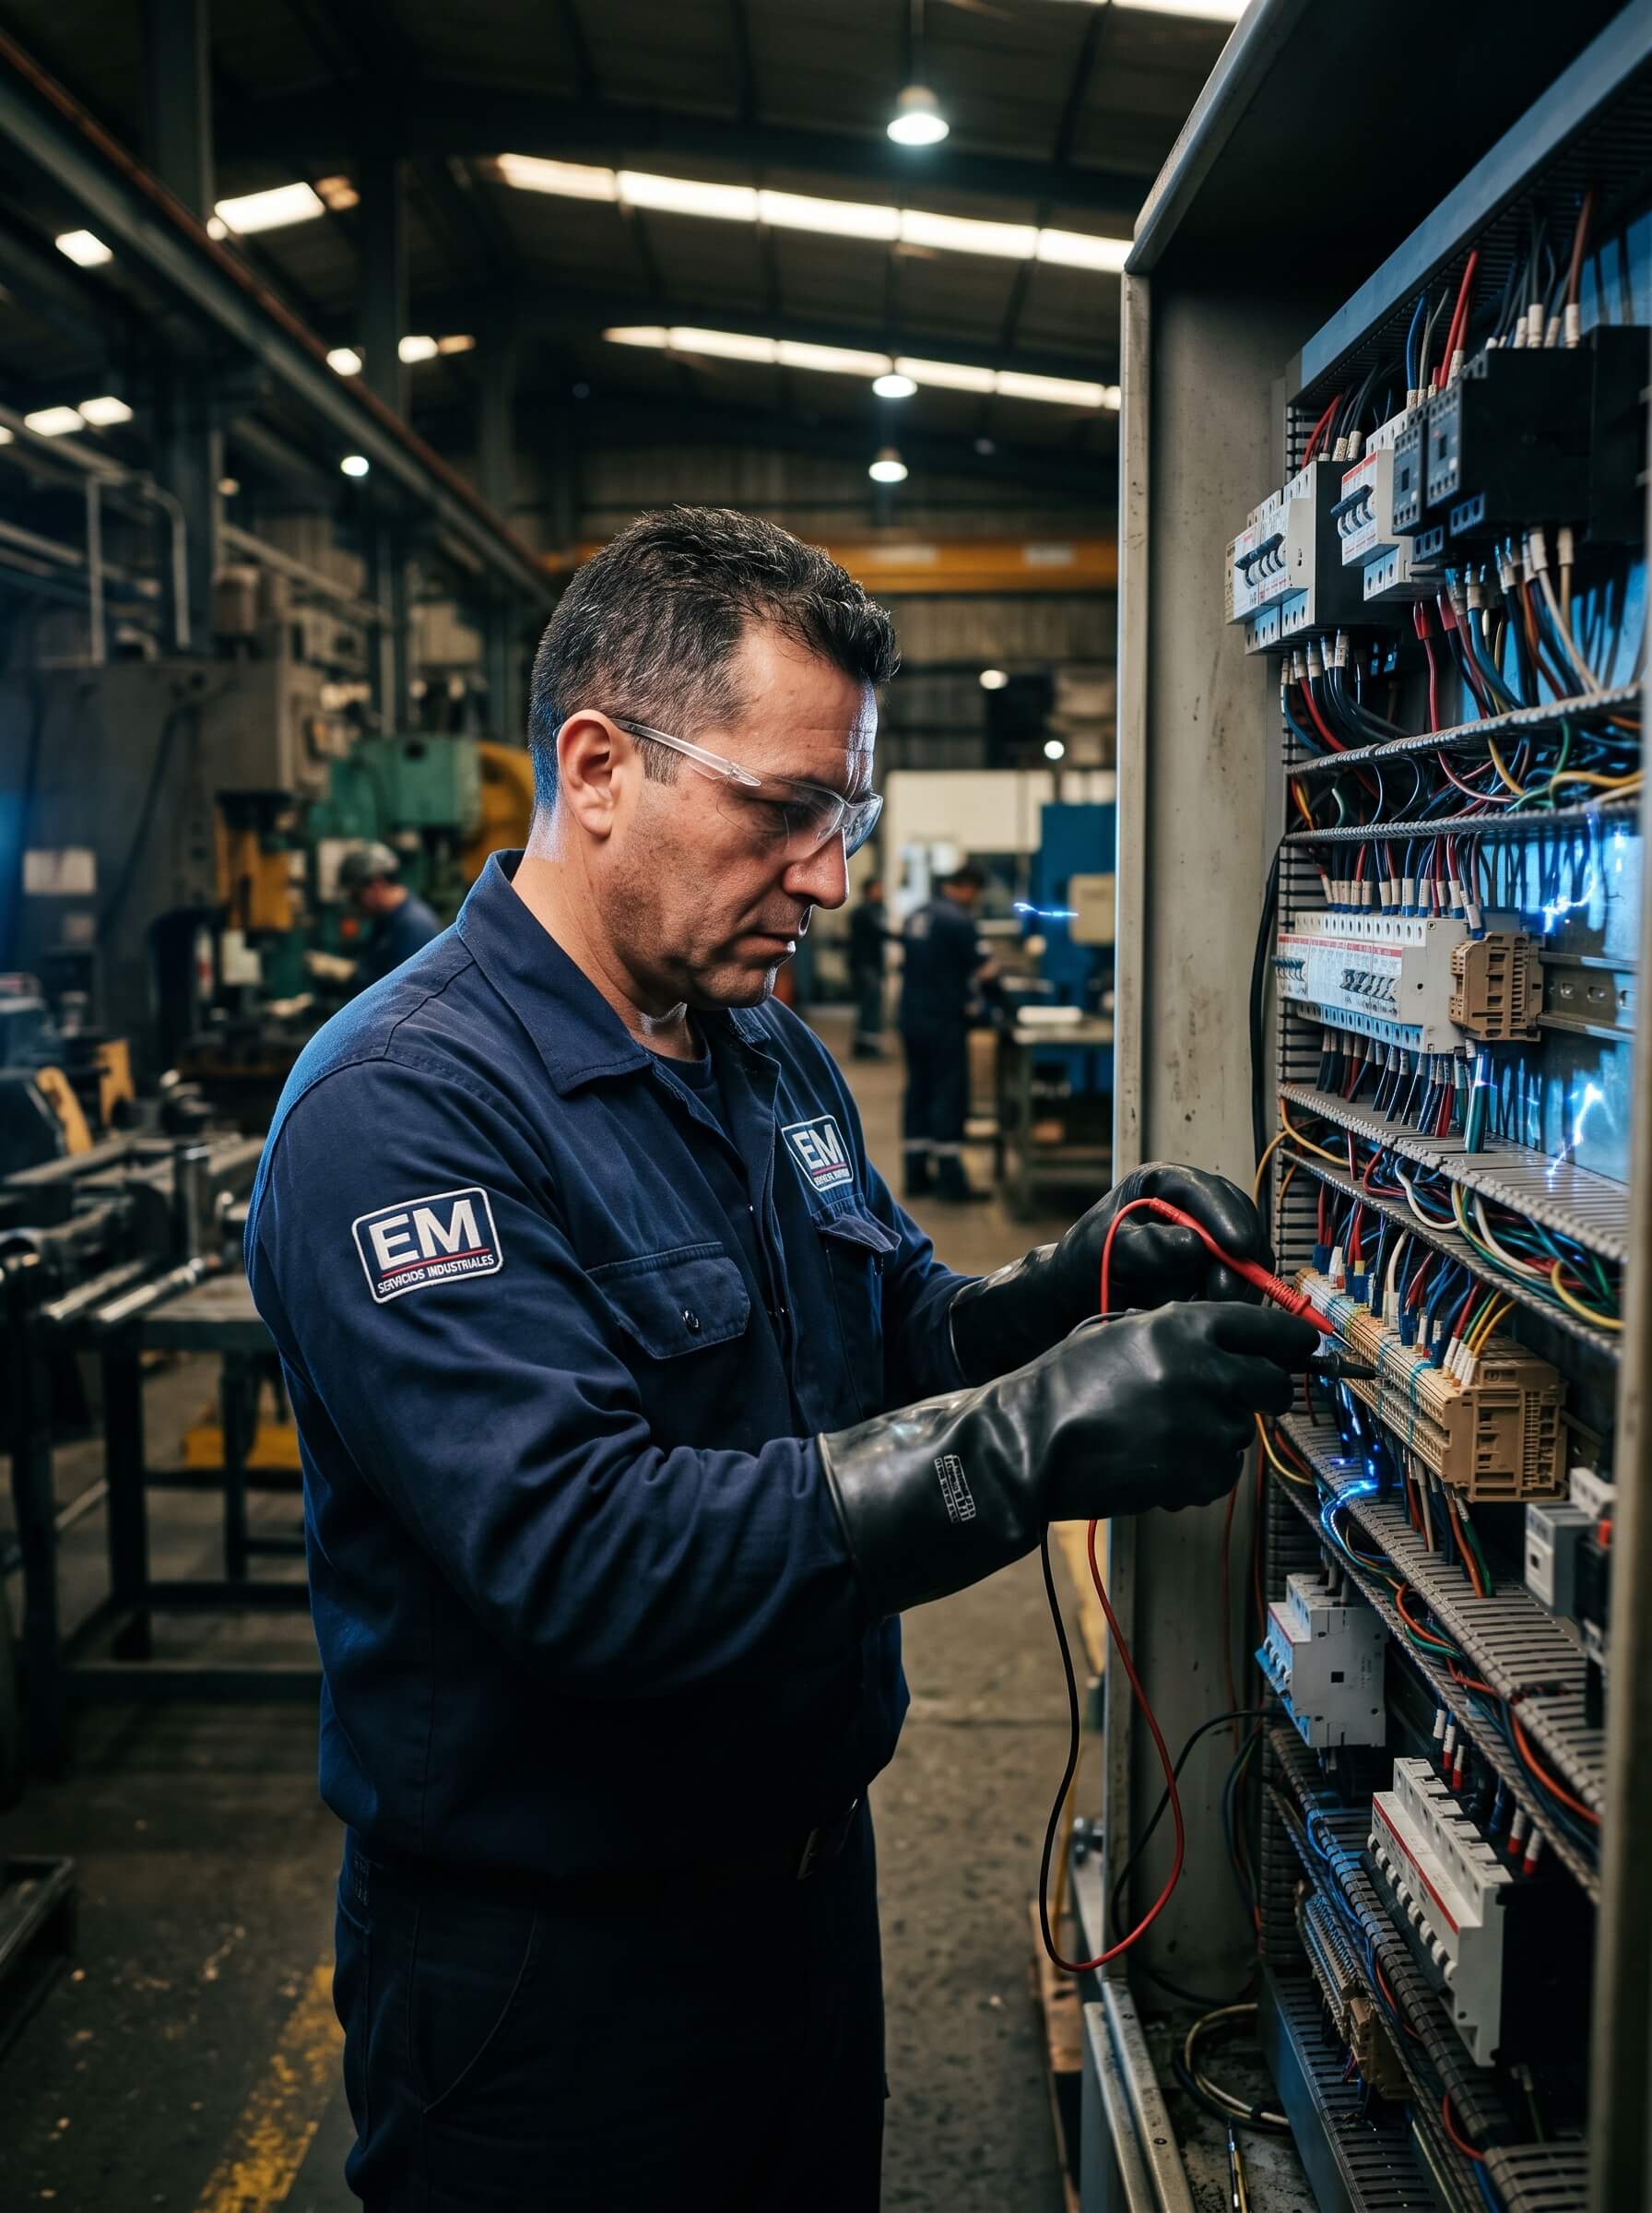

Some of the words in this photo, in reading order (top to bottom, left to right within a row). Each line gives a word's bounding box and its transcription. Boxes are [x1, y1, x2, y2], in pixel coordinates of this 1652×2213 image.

[792, 1124, 844, 1169] EM
[369, 1200, 482, 1270] EM
[427, 1254, 494, 1277] INDUSTRIALES
